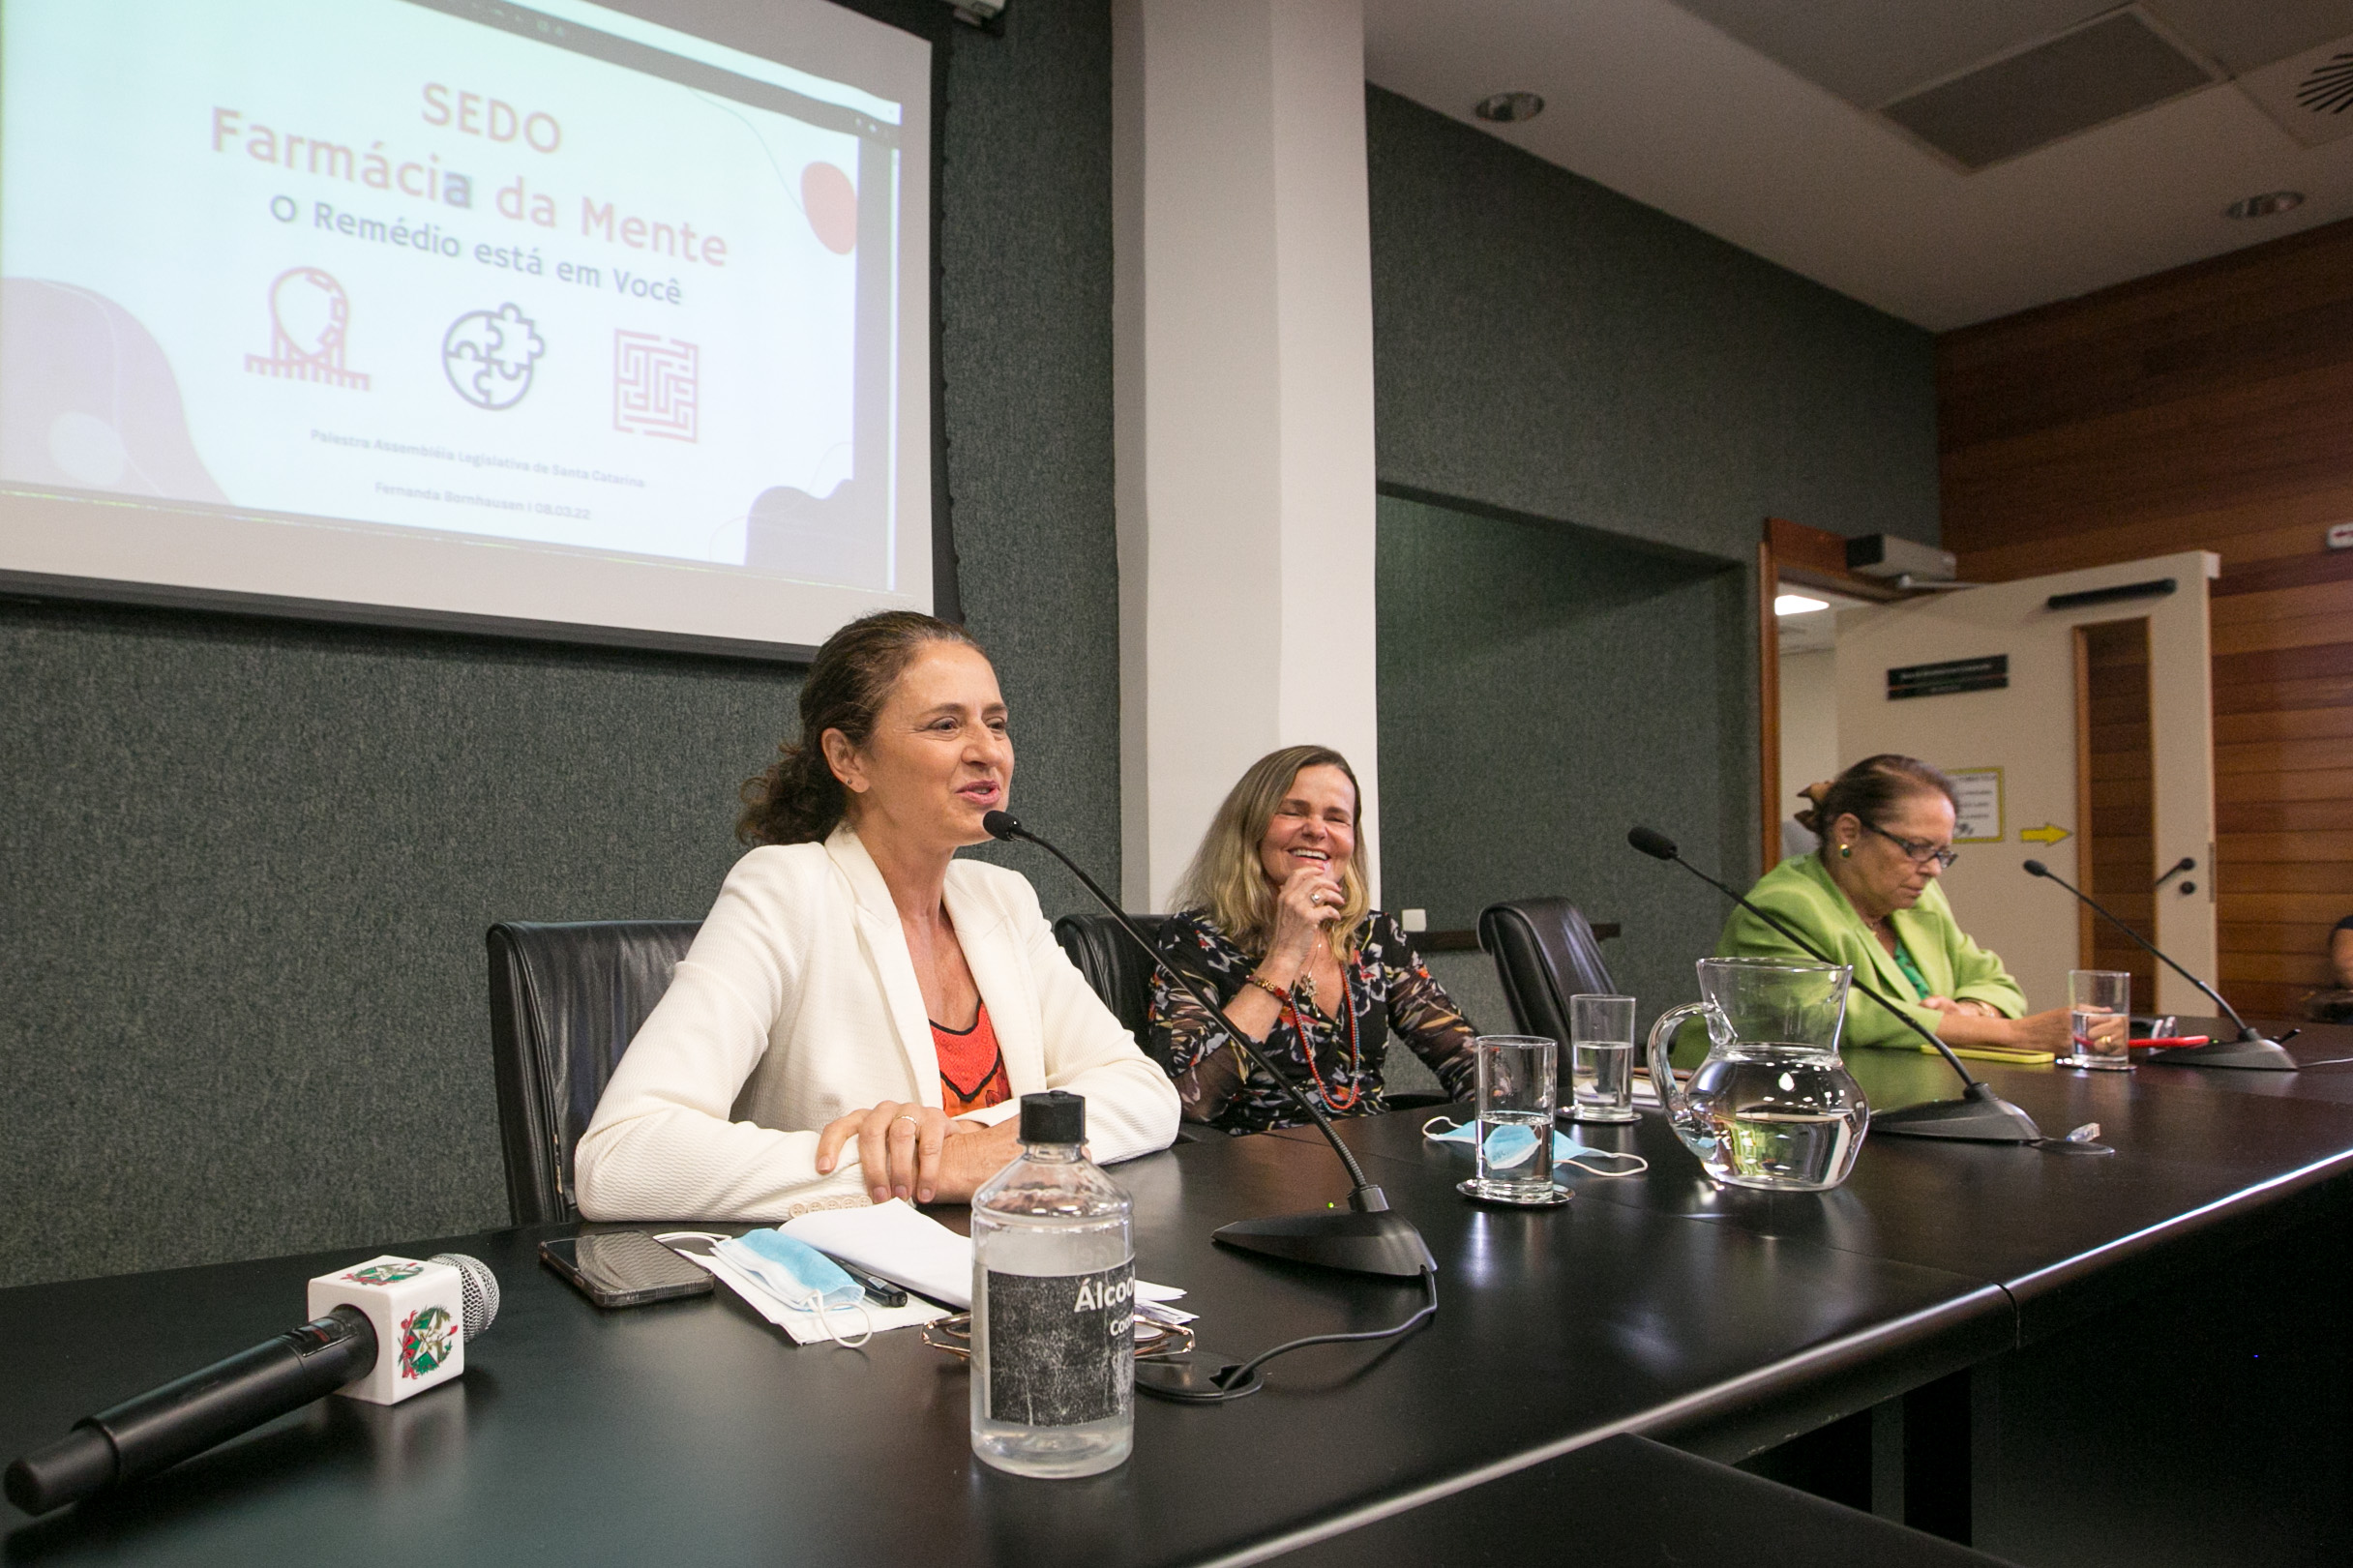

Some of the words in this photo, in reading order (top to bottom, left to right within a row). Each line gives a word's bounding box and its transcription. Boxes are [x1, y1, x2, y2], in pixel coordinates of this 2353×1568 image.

[422, 82, 560, 153] SEDO
[212, 106, 472, 209] Farmácia
[495, 175, 557, 228] da
[581, 195, 728, 267] Mente
[270, 194, 297, 222] O
[313, 201, 460, 256] Remédio
[474, 243, 543, 276] está
[556, 261, 601, 288] em
[613, 267, 682, 305] Você
[311, 429, 371, 449] Palestra
[459, 450, 530, 471] Legislativa
[533, 461, 549, 474] de
[552, 463, 589, 480] Santa
[592, 469, 645, 488] Catarina
[374, 482, 440, 501] Fernanda
[444, 490, 524, 511] Bornhausen
[535, 502, 591, 520] 08.03.22
[1074, 1277, 1134, 1313] Álcoo
